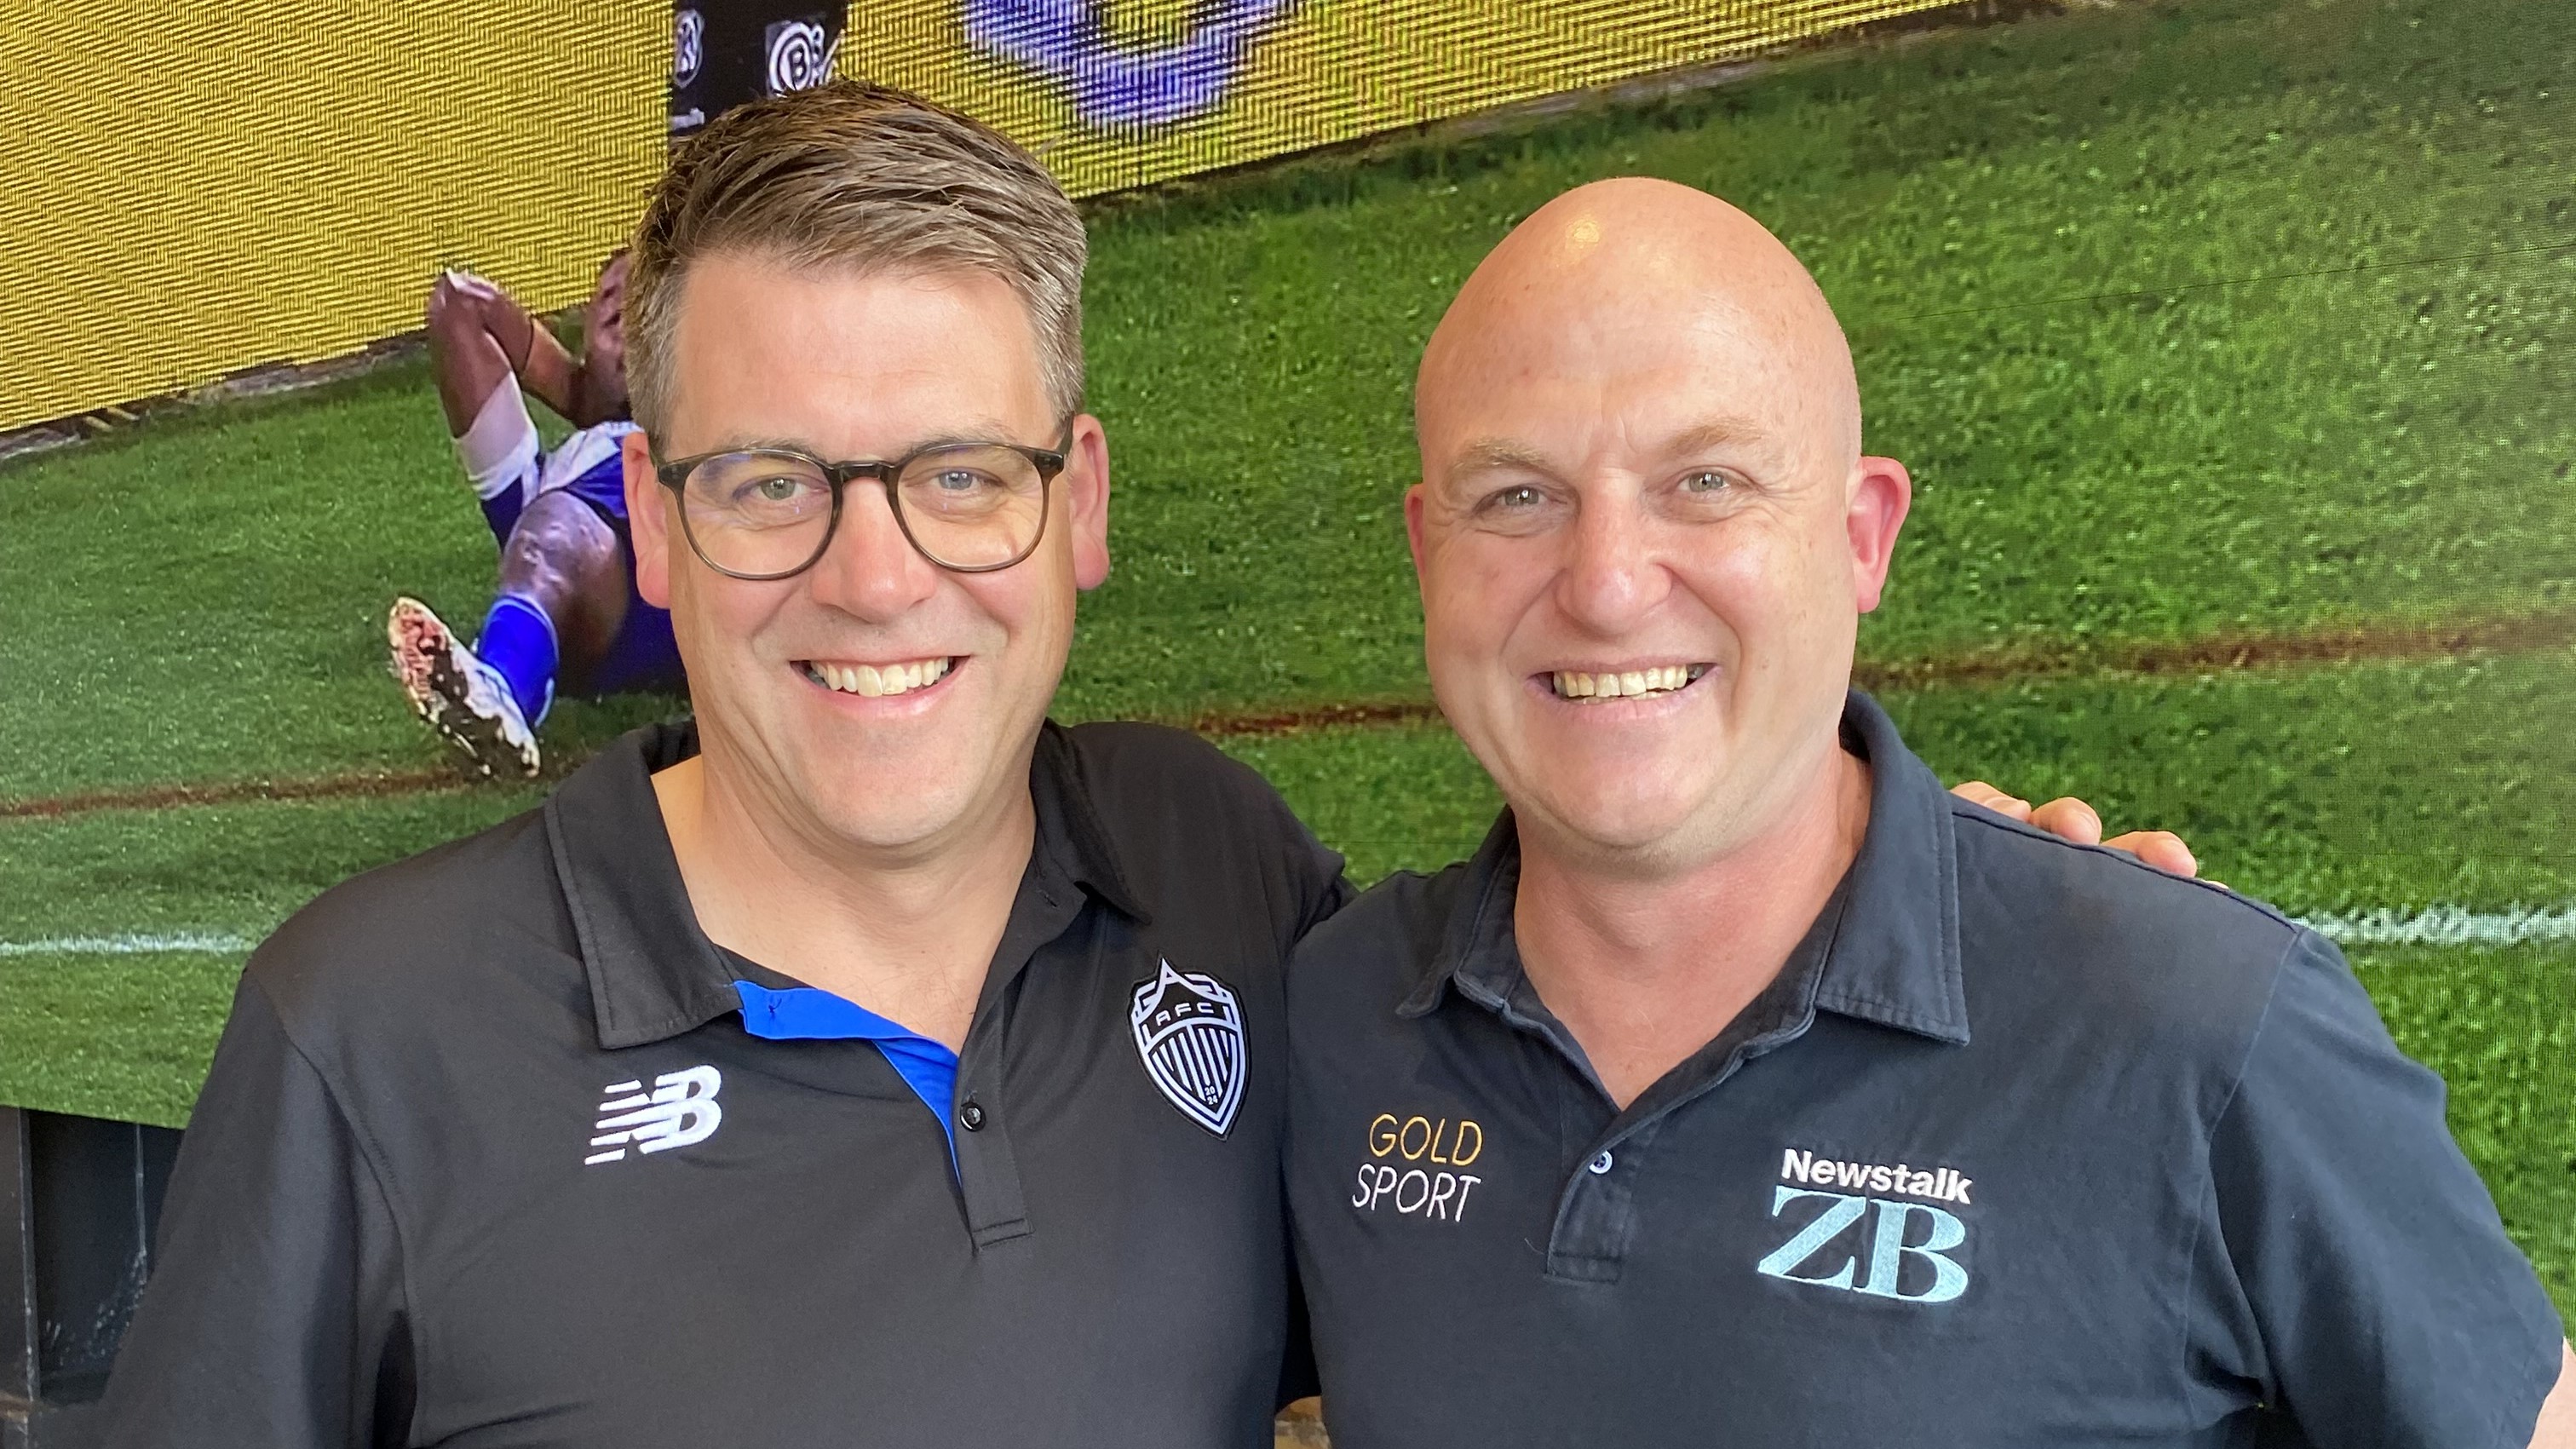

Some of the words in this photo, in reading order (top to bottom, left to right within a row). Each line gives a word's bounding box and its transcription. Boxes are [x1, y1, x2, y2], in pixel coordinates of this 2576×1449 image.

[1155, 1002, 1215, 1026] AFC
[1205, 1085, 1216, 1096] 20
[1207, 1095, 1218, 1105] 24
[1369, 1113, 1483, 1166] GOLD
[1352, 1163, 1482, 1222] SPORT
[1781, 1148, 1973, 1205] Newstalk
[1757, 1185, 1969, 1302] ZB
